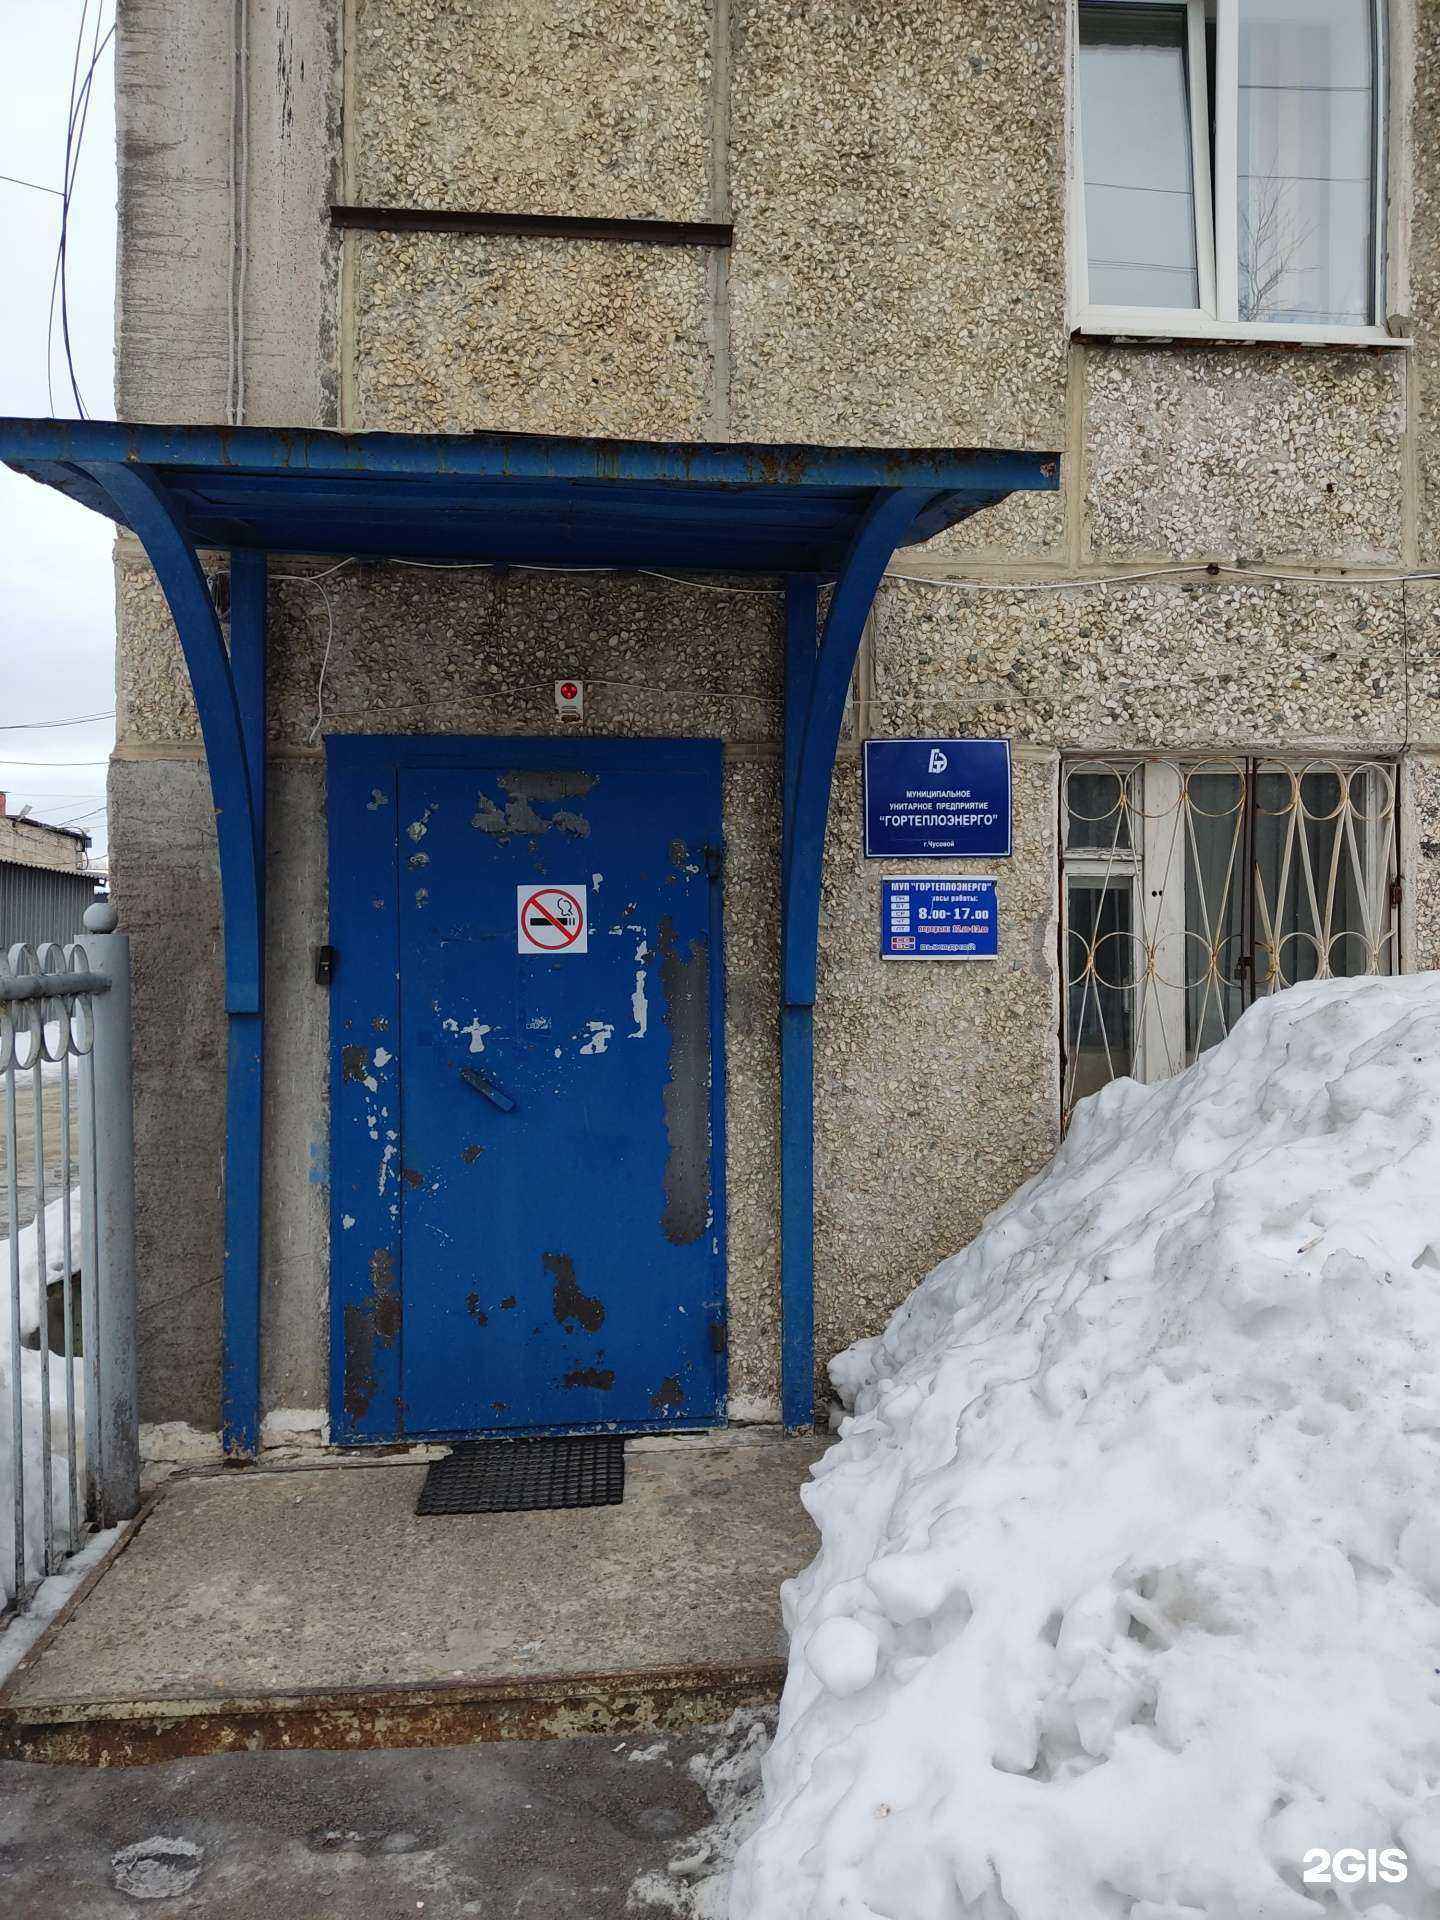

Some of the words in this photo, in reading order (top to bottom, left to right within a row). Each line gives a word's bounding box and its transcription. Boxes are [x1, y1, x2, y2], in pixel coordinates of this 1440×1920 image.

[906, 790, 971, 798] МУНИЦИПАЛЬНОЕ
[889, 802, 933, 810] УНИТАРНОЕ
[936, 802, 989, 810] ПРЕДПРИЯТИЕ
[879, 814, 998, 826] "ГОРТЕПЛОЭНЕРГО"
[891, 882, 910, 891] МУП
